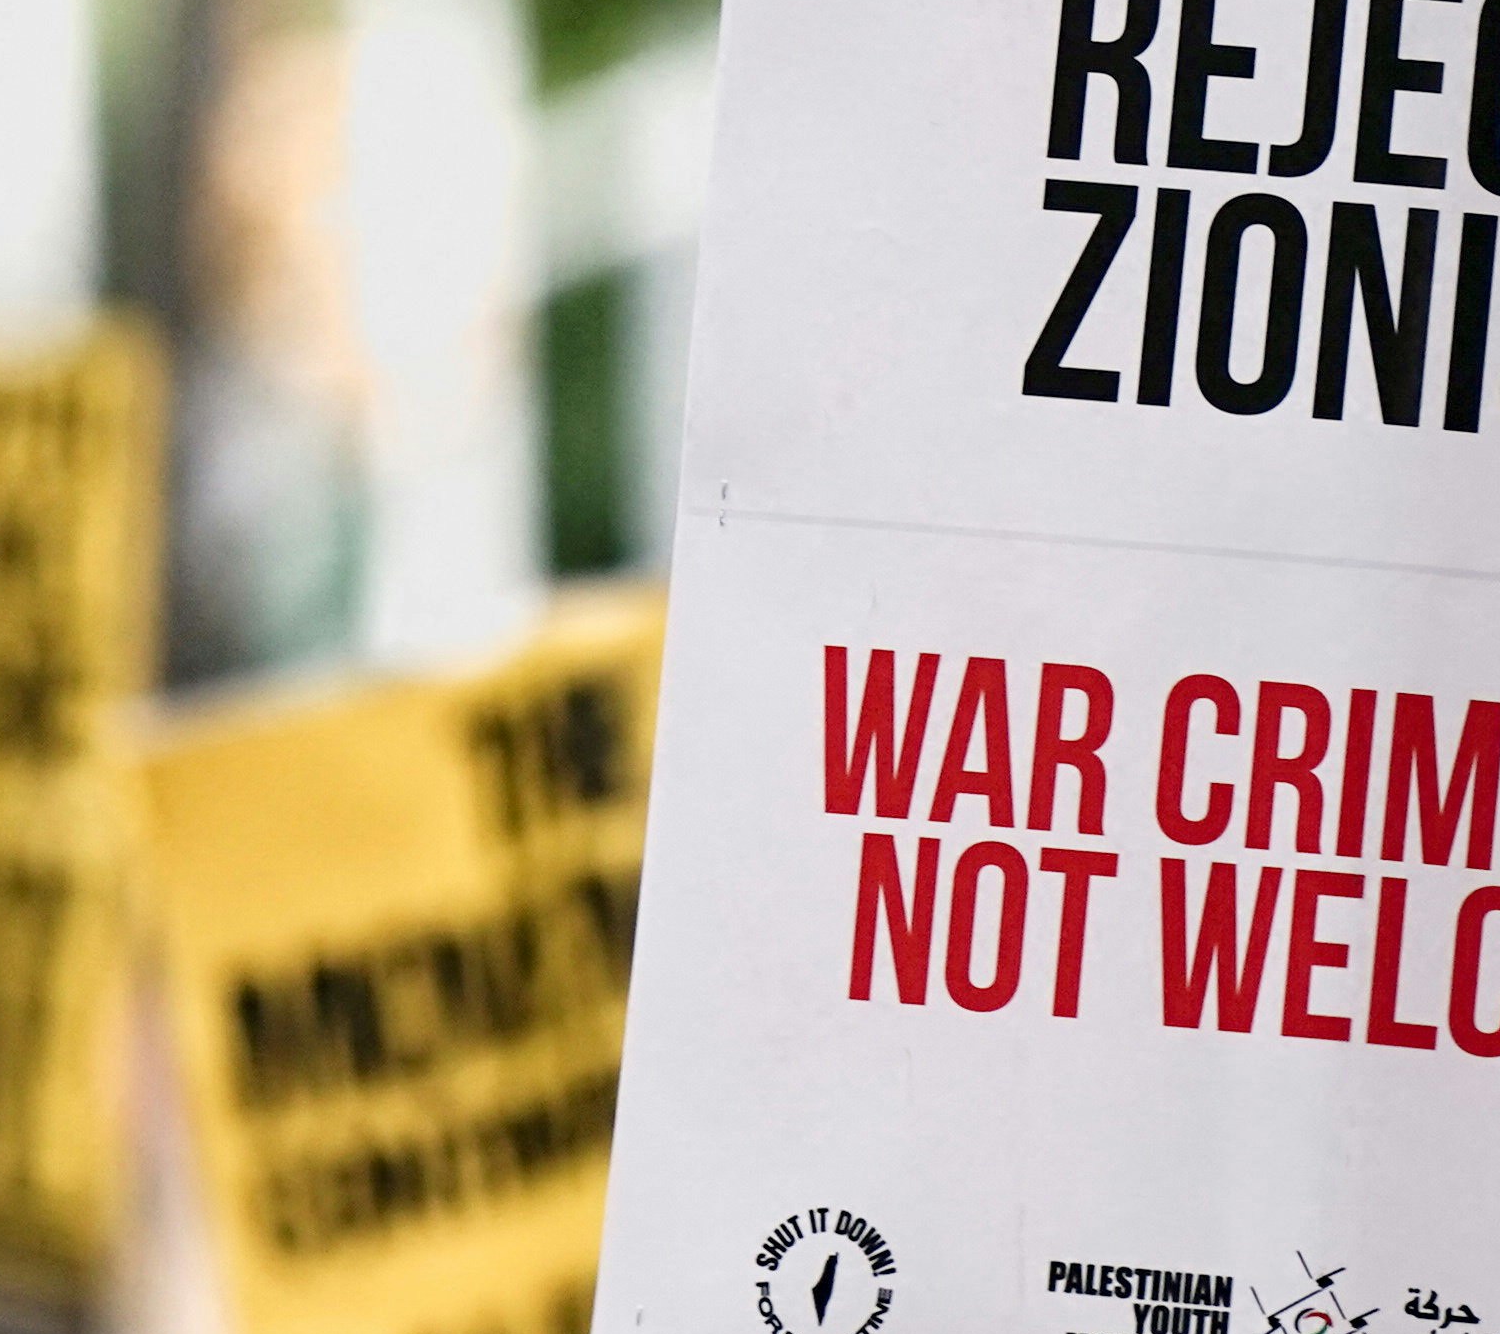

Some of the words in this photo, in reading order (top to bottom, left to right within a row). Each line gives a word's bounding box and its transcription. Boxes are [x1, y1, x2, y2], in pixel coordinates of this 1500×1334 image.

[824, 645, 1115, 836] WAR
[848, 832, 1119, 1019] NOT
[756, 1214, 804, 1272] SHUT
[808, 1207, 830, 1235] IT
[834, 1209, 898, 1278] DOWN!
[1047, 1260, 1234, 1308] PALESTINIAN
[1404, 1287, 1482, 1330] حركة
